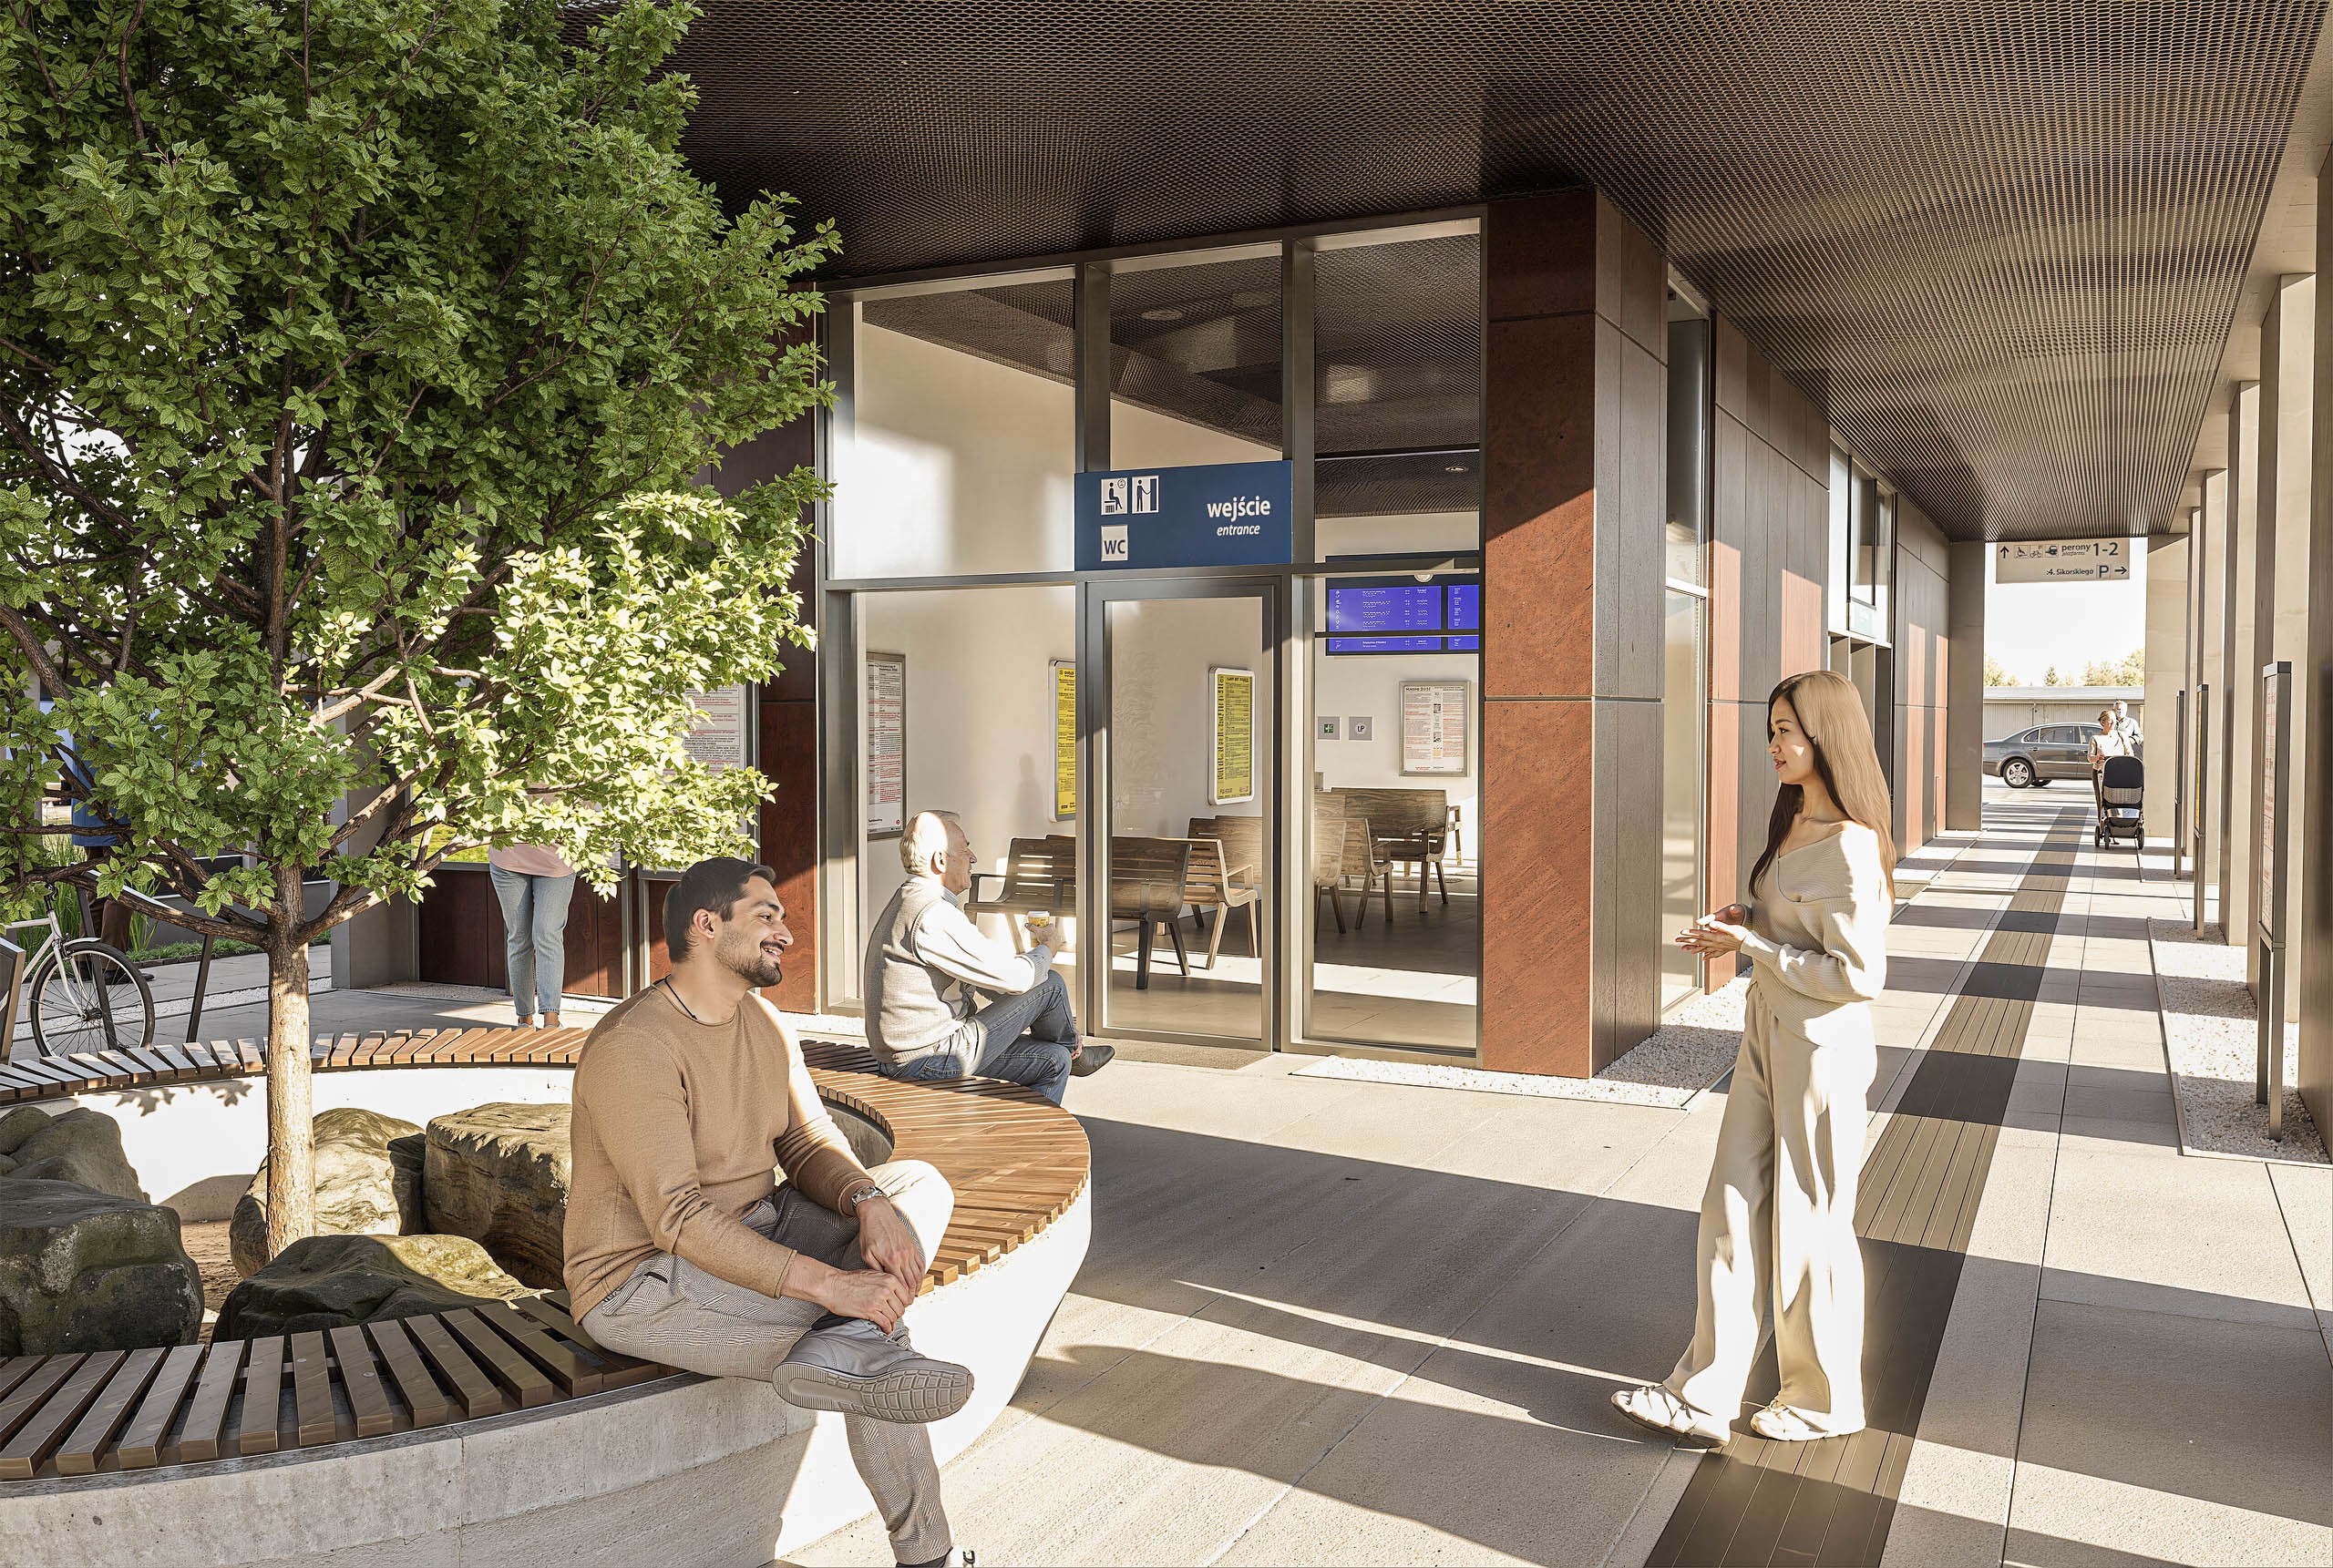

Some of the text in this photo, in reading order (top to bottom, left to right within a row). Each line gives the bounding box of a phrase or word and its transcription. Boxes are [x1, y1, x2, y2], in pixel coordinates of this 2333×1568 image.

[1207, 496, 1271, 522] wejście
[1217, 524, 1260, 536] entrance
[1104, 539, 1125, 555] WC
[2061, 542, 2119, 556] perony 1-2
[2099, 565, 2109, 578] P
